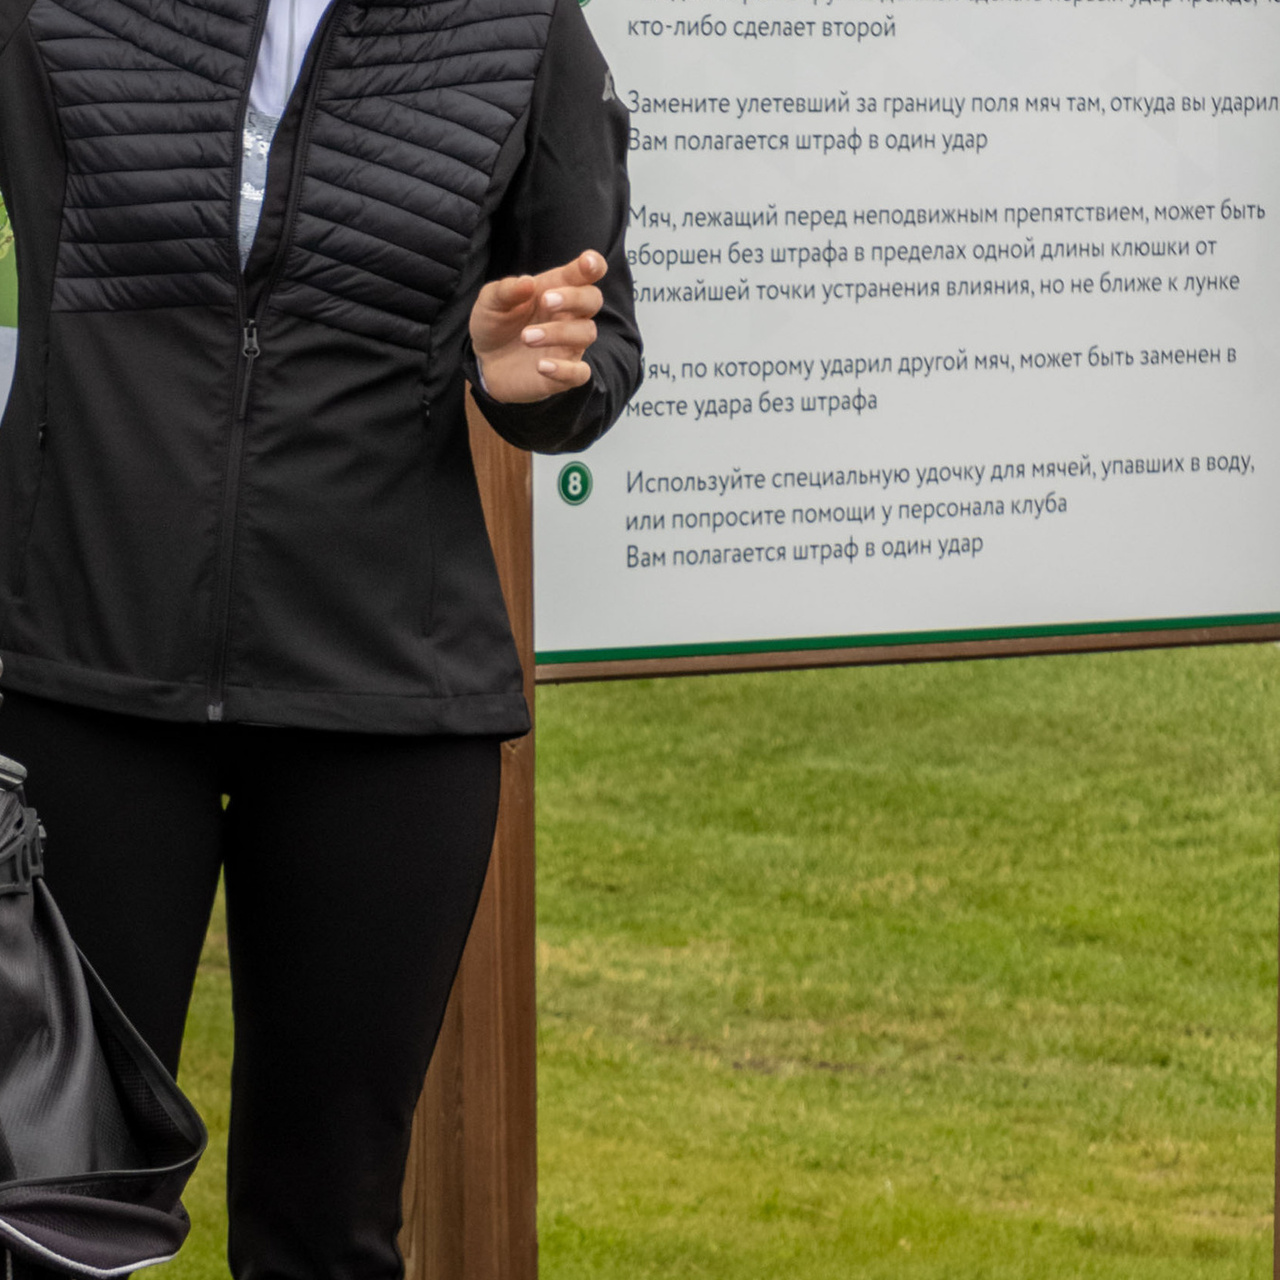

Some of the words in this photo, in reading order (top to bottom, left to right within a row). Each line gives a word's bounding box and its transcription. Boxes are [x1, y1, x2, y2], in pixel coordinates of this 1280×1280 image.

[627, 11, 728, 37] кто-либо
[732, 18, 817, 40] сделает
[821, 13, 896, 43] второй
[626, 89, 730, 114] Замените
[735, 89, 850, 119] улетевший
[855, 95, 878, 113] за
[883, 95, 966, 119] границу
[971, 95, 1019, 112] поля
[1024, 95, 1061, 112] мяч
[1065, 94, 1106, 115] там,
[1109, 94, 1176, 118] откуда
[1181, 94, 1206, 112] вы
[1210, 94, 1279, 117] ударил
[628, 205, 678, 232] Мяч,
[680, 202, 778, 229] лежащий
[784, 208, 849, 231] перед
[852, 206, 998, 227] неподвижным
[1003, 204, 1150, 228] препятствием,
[1153, 203, 1216, 221] может
[1219, 196, 1266, 220] быть
[627, 241, 723, 272] вборшен
[727, 239, 765, 264] без
[770, 237, 849, 268] штрафа
[853, 244, 866, 262] в
[870, 243, 967, 267] пределах
[971, 235, 1036, 262] одной
[1039, 241, 1105, 261] длины
[1110, 239, 1190, 257] клюшки
[1194, 238, 1218, 256] от
[568, 471, 582, 495] 8
[626, 465, 767, 496] Используйте
[770, 466, 911, 490] специальную
[915, 463, 986, 489] удочку
[989, 461, 1026, 483] для
[1031, 452, 1097, 479] мячей,
[1100, 456, 1185, 481] упавших
[1190, 455, 1201, 472] в
[1206, 453, 1255, 475] воду,
[625, 512, 666, 531] или
[671, 507, 787, 533] попросите
[791, 504, 876, 524] помощи
[880, 503, 893, 526] у
[898, 498, 1005, 524] персонала
[1010, 489, 1068, 520] клуба
[626, 543, 667, 568] Вам
[672, 544, 787, 565] полагается
[792, 533, 860, 565] штраф
[864, 540, 876, 557] в
[880, 537, 932, 559] один
[937, 535, 984, 560] удар
